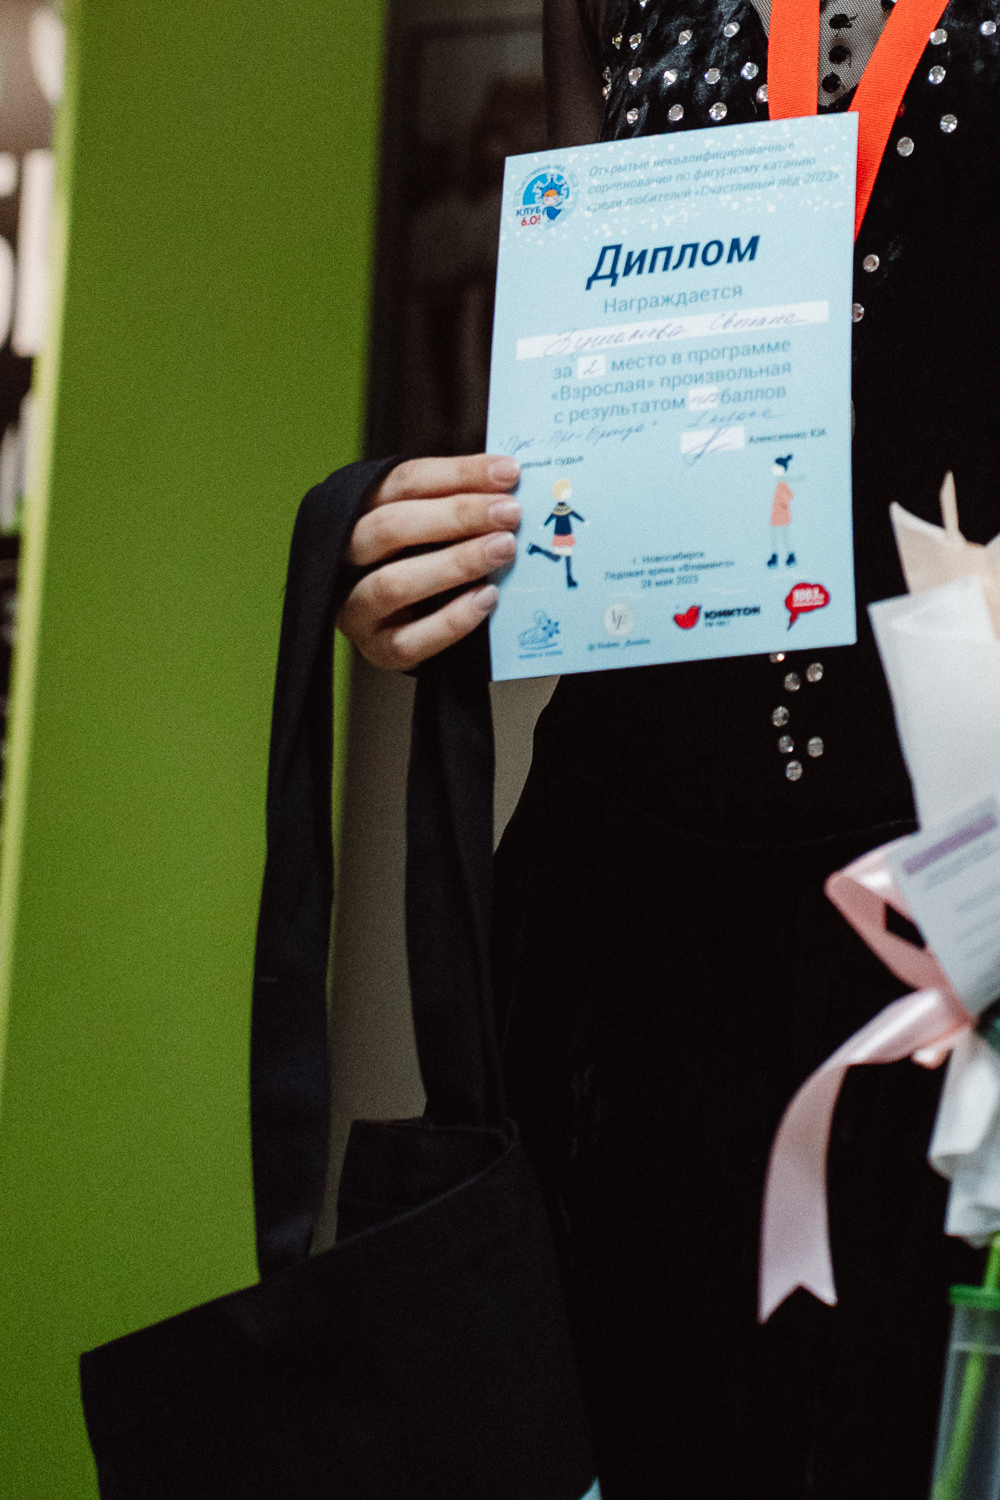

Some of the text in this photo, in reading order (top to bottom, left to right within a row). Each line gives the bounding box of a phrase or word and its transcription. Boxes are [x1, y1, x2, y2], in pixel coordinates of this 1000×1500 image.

[676, 173, 690, 183] по
[694, 164, 761, 181] фигурному
[763, 157, 817, 171] катанию
[516, 206, 541, 216] КЛУБ
[585, 234, 761, 291] Диплом
[603, 285, 743, 314] Награждается
[553, 366, 572, 380] за
[611, 354, 667, 372] место
[672, 352, 682, 365] в
[688, 340, 792, 365] программе
[551, 363, 792, 402] «Взрослая» произвольная
[554, 411, 564, 424] с
[569, 396, 686, 426] результатом
[721, 386, 787, 405] баллов
